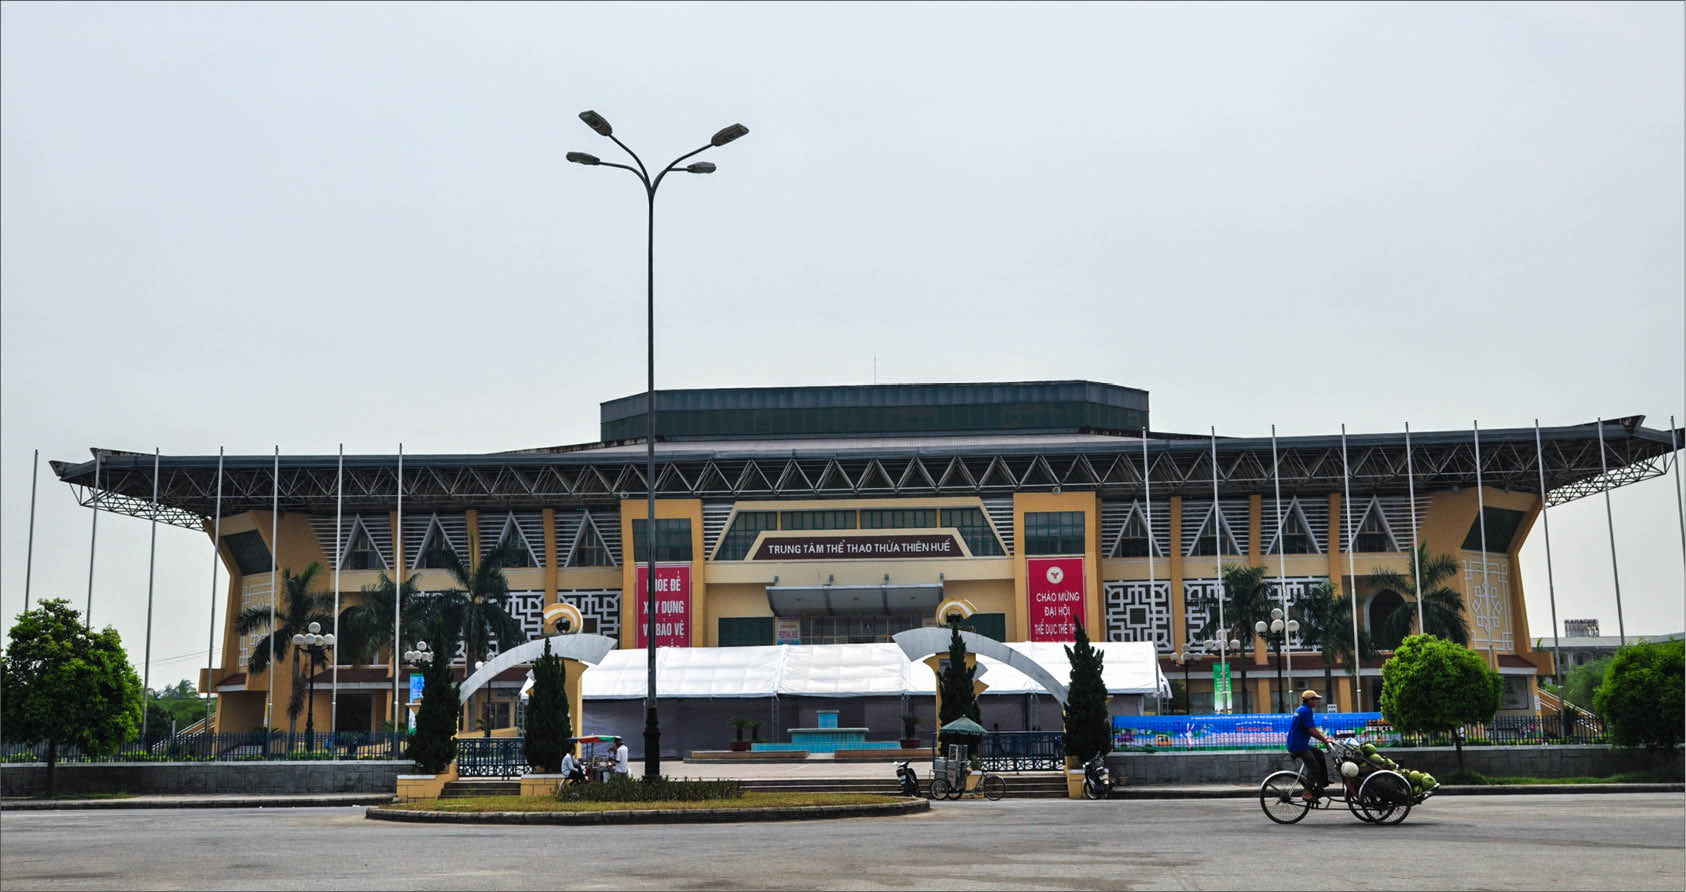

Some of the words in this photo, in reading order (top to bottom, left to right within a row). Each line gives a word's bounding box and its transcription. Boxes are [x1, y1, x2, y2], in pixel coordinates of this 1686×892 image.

[768, 544, 801, 554] TRUNG
[803, 542, 825, 554] TÂM
[826, 539, 845, 554] THỂ
[846, 543, 873, 553] THAO
[874, 539, 900, 553] THỪA
[902, 540, 929, 552] THIÊN
[930, 537, 951, 552] HUẾ
[643, 601, 660, 614] XY
